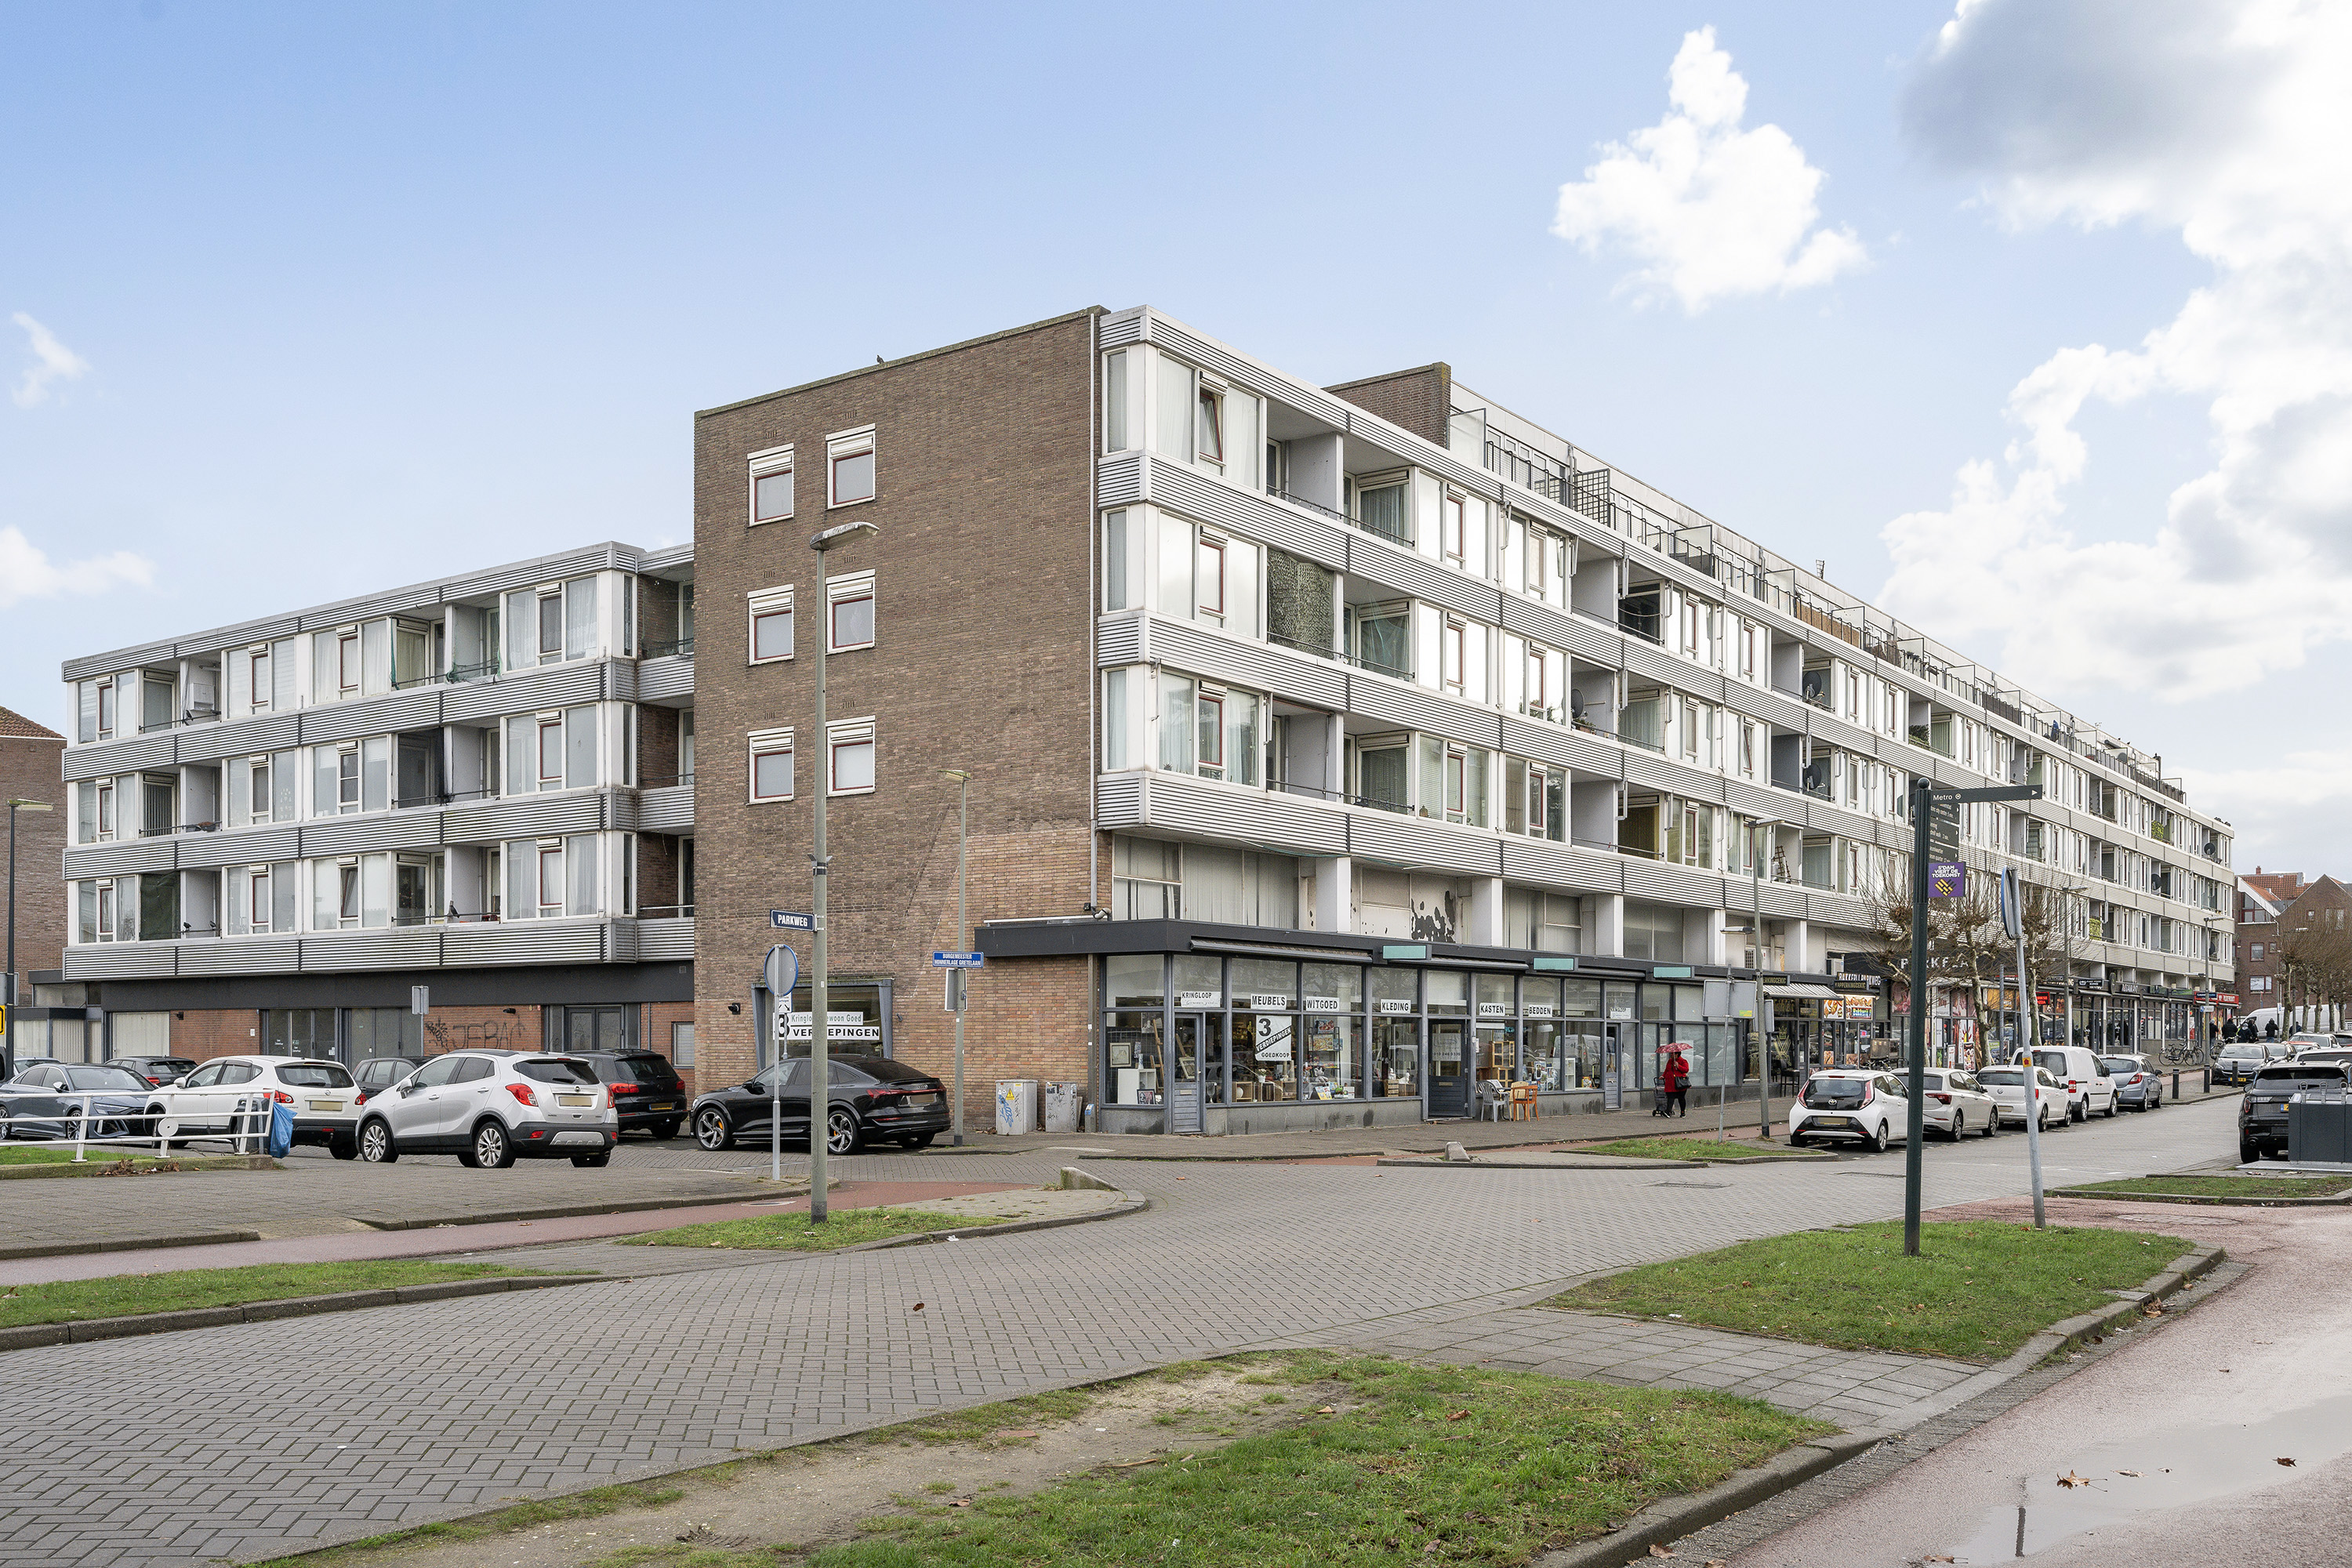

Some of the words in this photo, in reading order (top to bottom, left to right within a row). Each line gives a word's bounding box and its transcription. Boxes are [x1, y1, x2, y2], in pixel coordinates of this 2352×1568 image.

[778, 914, 808, 927] PARKWEG
[1251, 996, 1286, 1006] MEUBELS
[1306, 1000, 1338, 1009] WITGOED
[1381, 1002, 1410, 1011] KLEDING
[1480, 1005, 1504, 1014] KASTEN
[791, 1014, 813, 1024] Kringlo
[779, 1014, 790, 1037] 3
[1258, 1018, 1272, 1037] 3
[1256, 1025, 1291, 1051] VERDIEPINGEN
